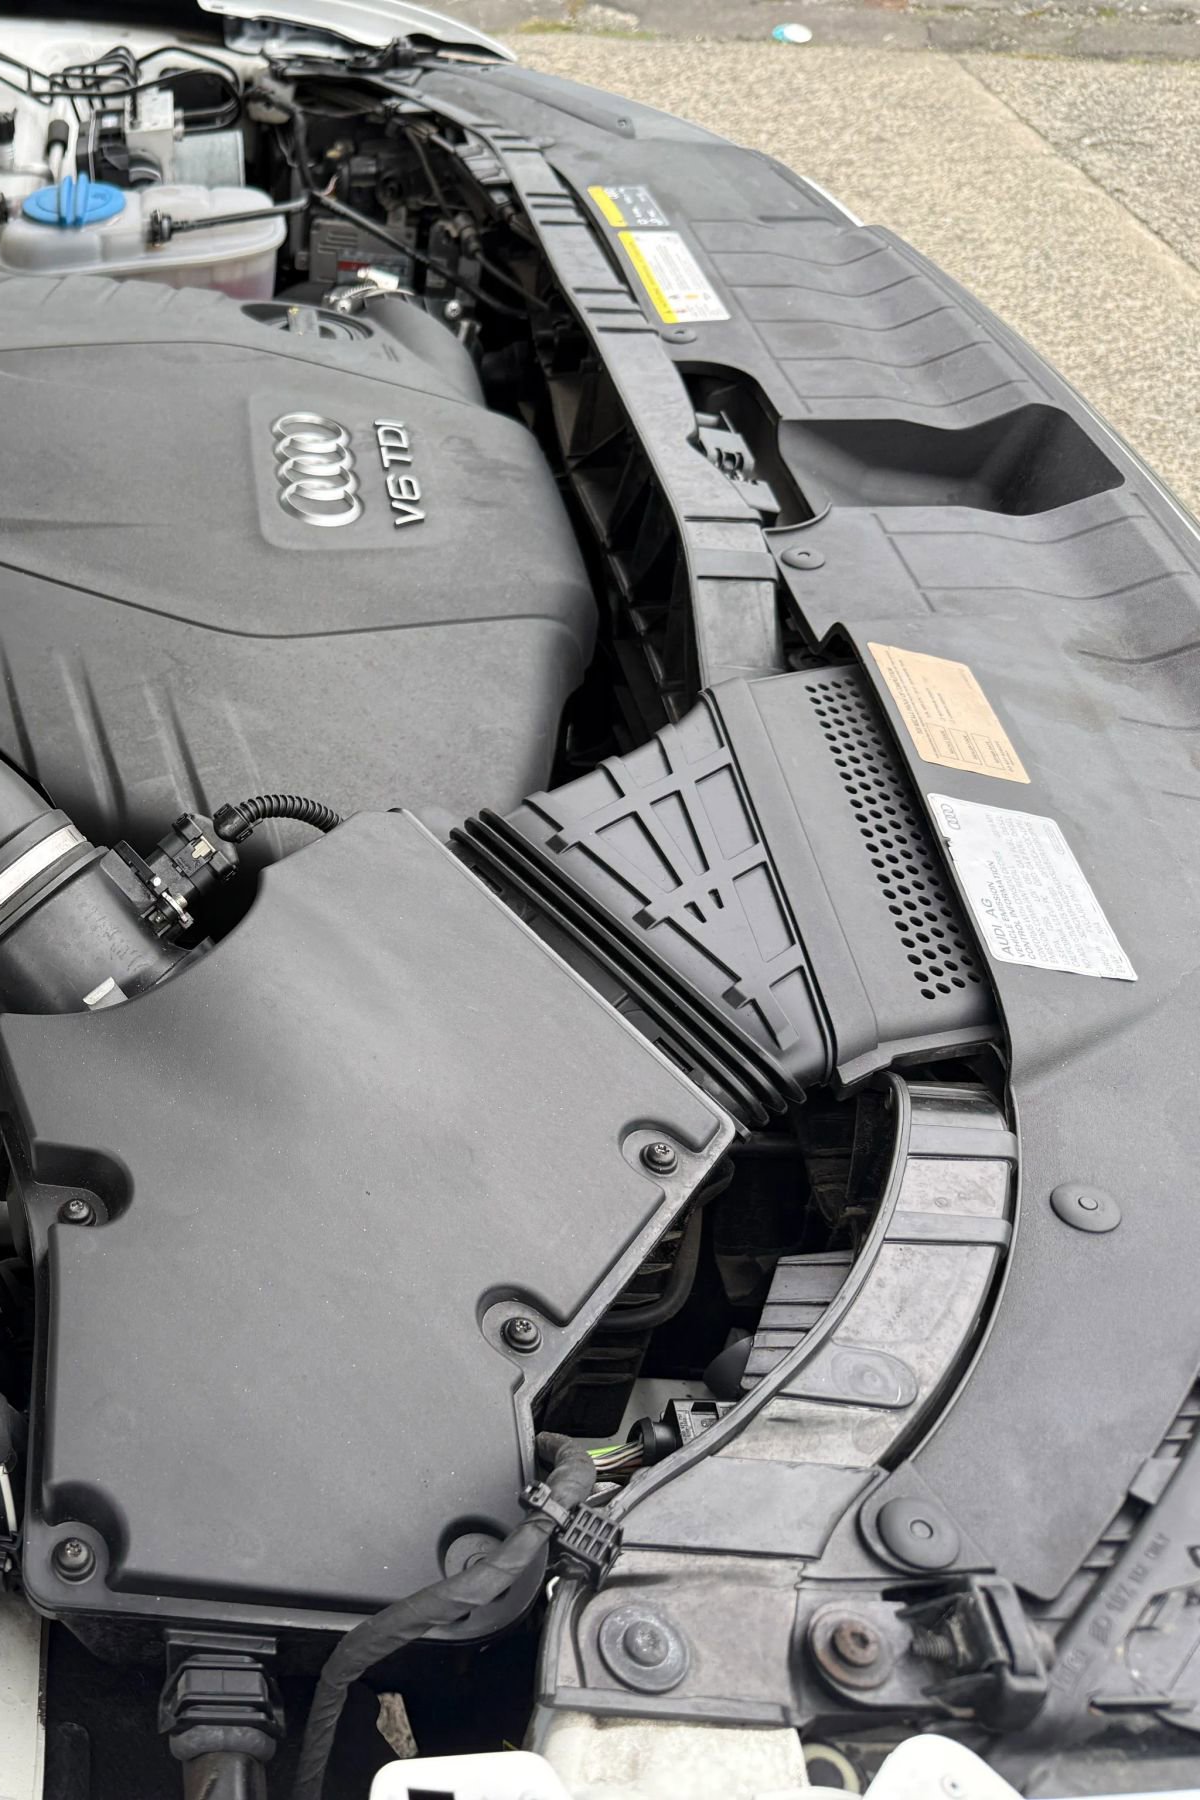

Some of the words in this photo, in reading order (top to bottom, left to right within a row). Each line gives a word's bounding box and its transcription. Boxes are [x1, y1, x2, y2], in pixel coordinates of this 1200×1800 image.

[374, 418, 412, 468] TDI
[386, 474, 426, 526] V6
[978, 896, 999, 918] AG
[985, 859, 1019, 918] INFORMATION
[985, 880, 1010, 921] EMISSION
[990, 923, 1015, 956] AUDI
[1003, 920, 1027, 958] VEHICLE
[1011, 918, 1037, 960] CONTROL
